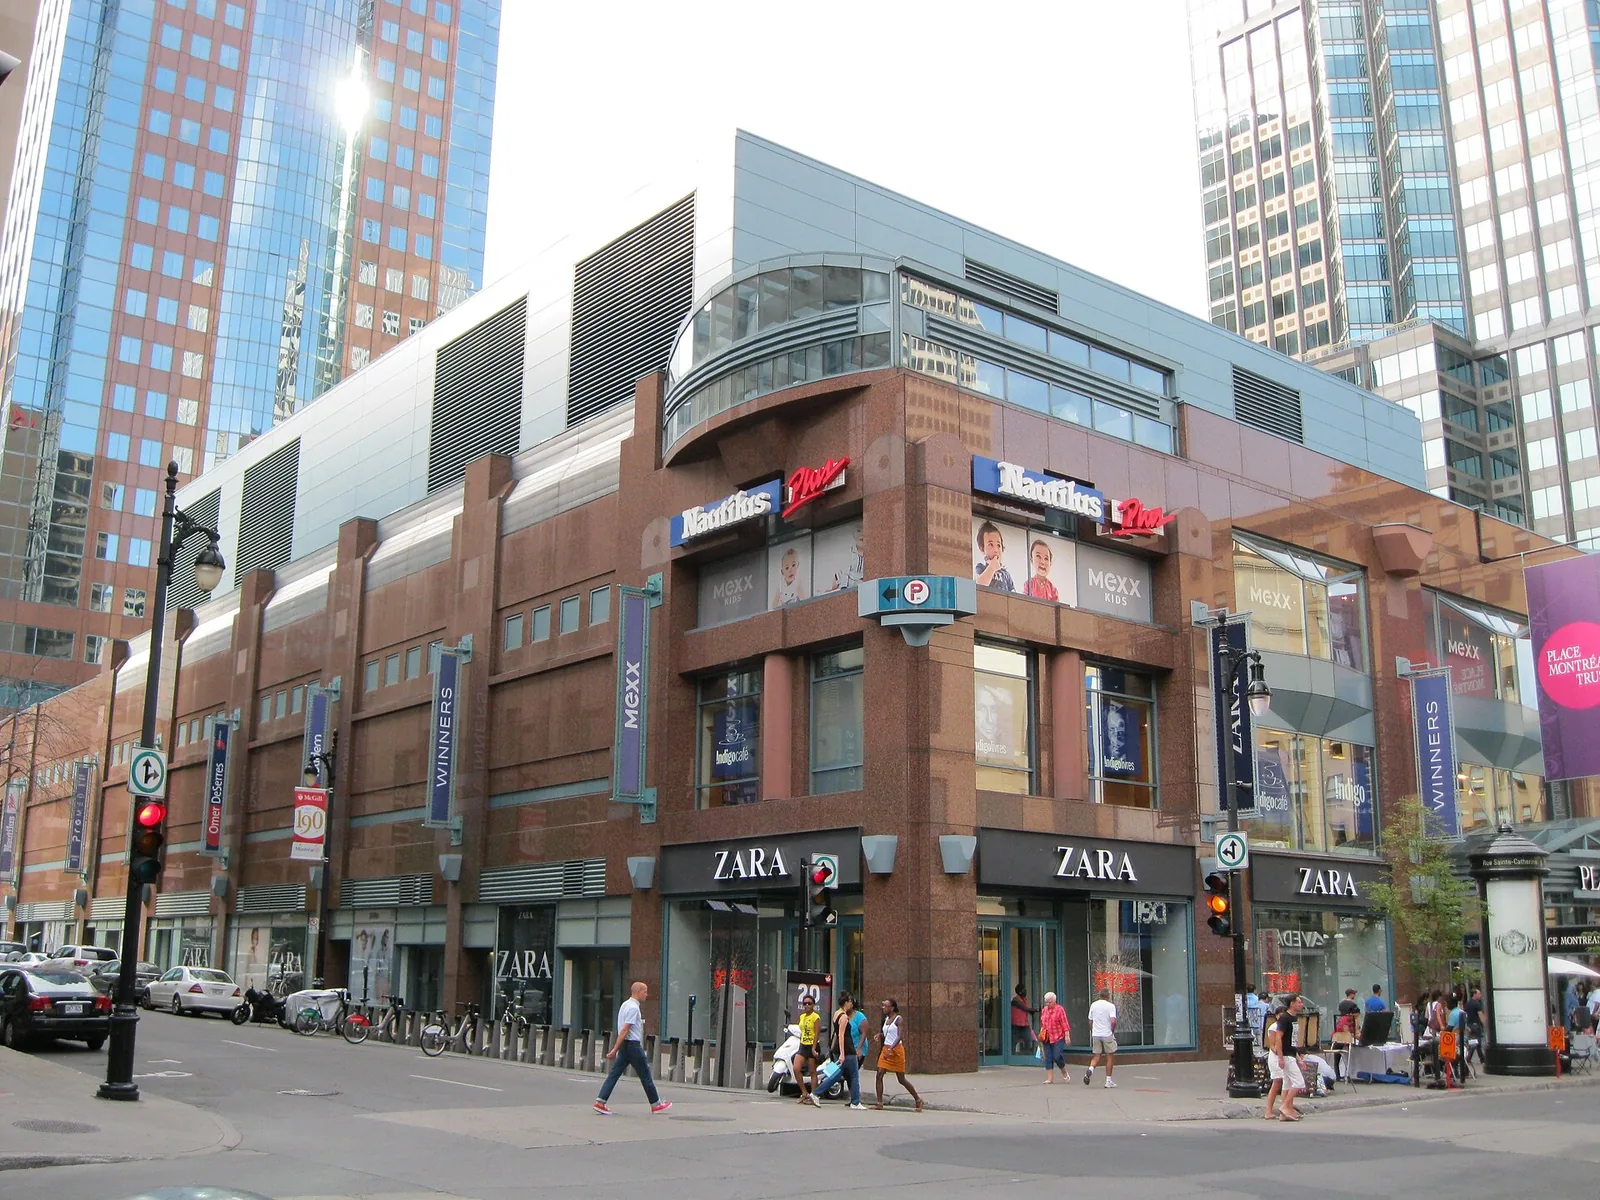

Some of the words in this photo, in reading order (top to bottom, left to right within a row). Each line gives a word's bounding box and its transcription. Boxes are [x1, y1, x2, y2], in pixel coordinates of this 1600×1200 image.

[997, 461, 1103, 517] Nautilus
[681, 490, 772, 539] Nautilus
[724, 594, 742, 606] KIDS
[1104, 593, 1128, 606] KIDS
[1546, 645, 1582, 663] PLACE
[1576, 670, 1600, 686] TRU
[436, 686, 453, 788] WINNERS
[1426, 700, 1445, 811] WINNERS
[211, 762, 225, 805] DeSerres
[304, 794, 323, 802] McGill
[208, 806, 220, 834] Omer
[295, 810, 324, 835] 190
[713, 848, 789, 880] ZARA
[1056, 846, 1138, 881] ZARA
[1299, 867, 1359, 897] ZARA
[182, 947, 209, 968] ZARA
[271, 951, 303, 973] ZARA
[497, 950, 552, 979] ZARA
